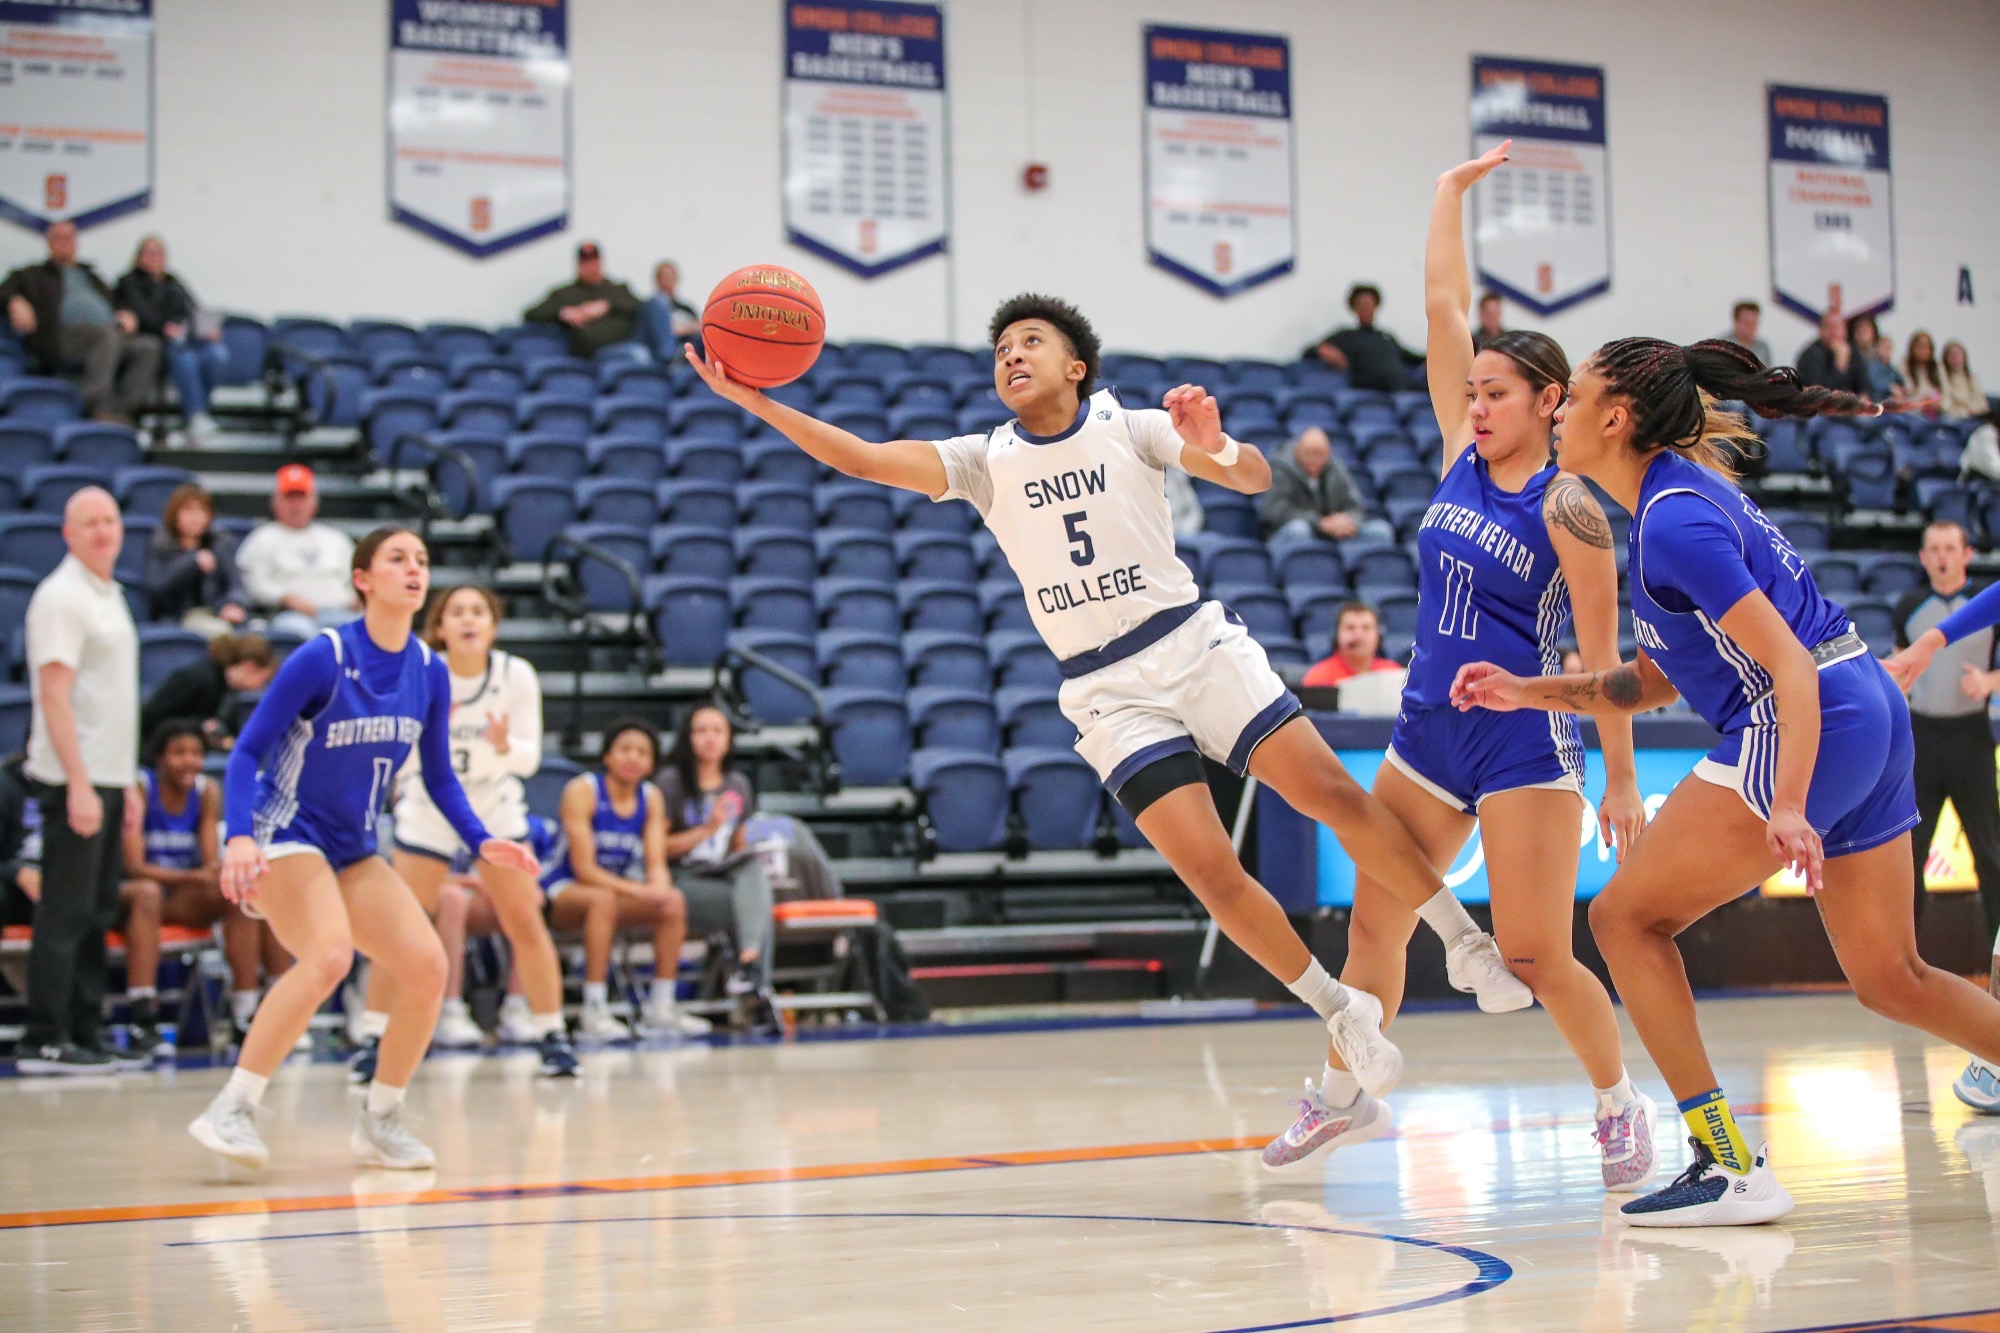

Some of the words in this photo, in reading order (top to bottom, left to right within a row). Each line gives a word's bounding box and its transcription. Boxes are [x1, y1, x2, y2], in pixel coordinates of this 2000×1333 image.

[1957, 264, 1974, 305] A
[731, 300, 811, 332] SPALDING
[1024, 463, 1105, 509] SNOW
[1062, 510, 1095, 567] 5
[1418, 502, 1485, 540] OUTHERN
[1476, 520, 1536, 582] NEVADA
[1037, 564, 1147, 614] COLLEGE
[1438, 550, 1480, 640] 11
[325, 716, 397, 748] SOUTHERN
[453, 747, 471, 774] 3
[1702, 1104, 1742, 1171] BALLISLIFE
